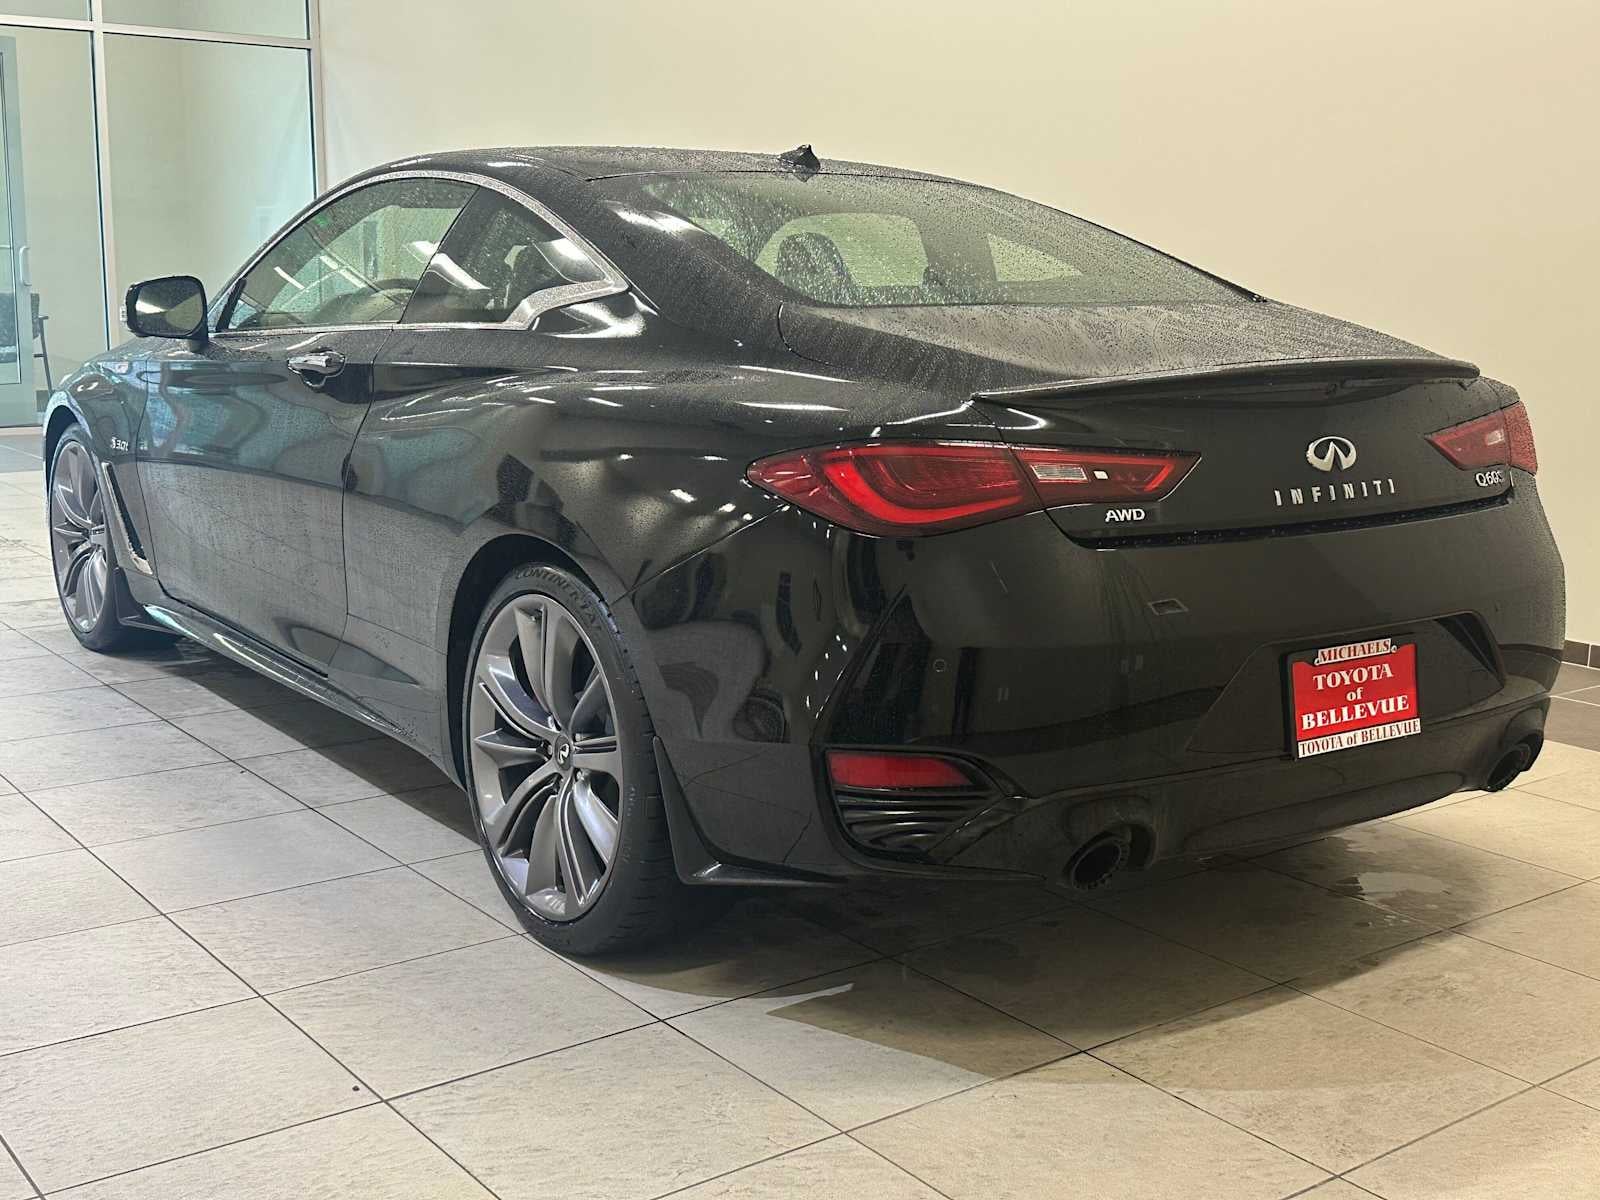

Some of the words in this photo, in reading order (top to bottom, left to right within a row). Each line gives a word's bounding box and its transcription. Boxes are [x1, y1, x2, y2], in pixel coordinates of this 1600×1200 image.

[1274, 478, 1395, 506] INFINITI
[1105, 508, 1146, 522] AWD
[1320, 640, 1390, 661] MICHAELS
[1313, 663, 1393, 690] TOYOTA
[1346, 687, 1363, 701] of
[1301, 695, 1409, 730] BELLEVUE
[1300, 737, 1343, 755] TOYOTA
[1346, 734, 1358, 745] of
[1361, 720, 1419, 741] BELLEVUE
